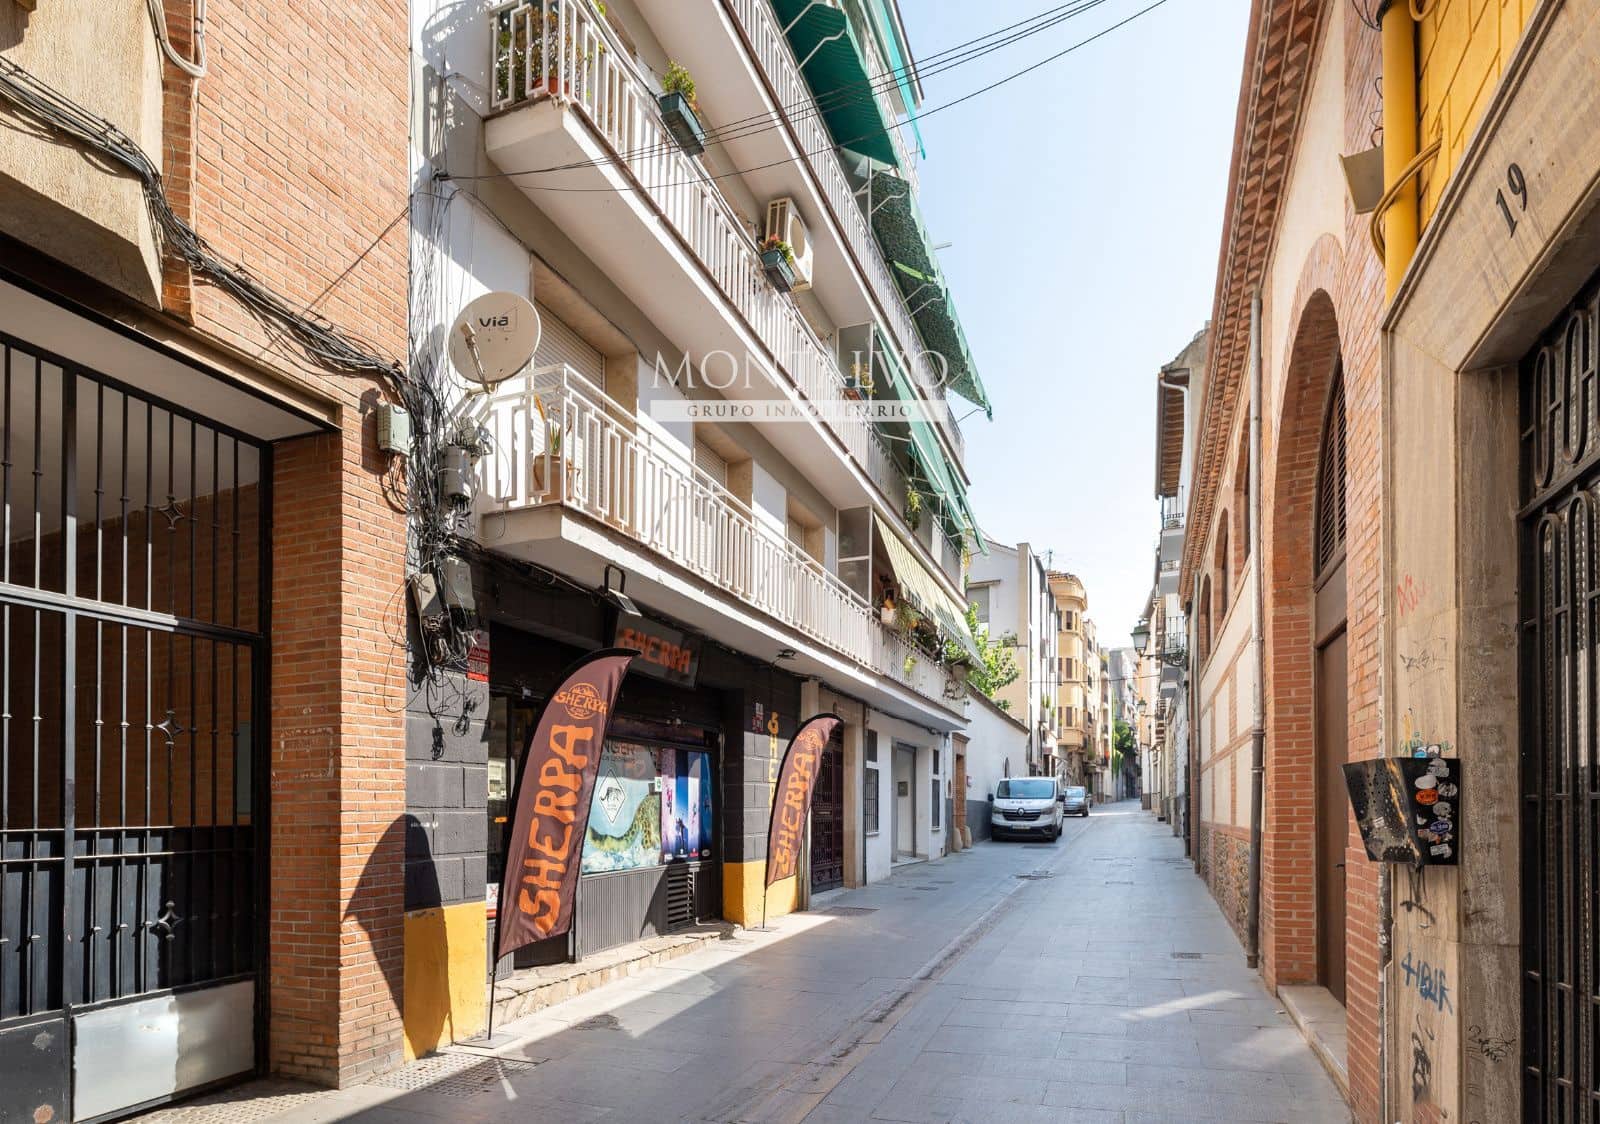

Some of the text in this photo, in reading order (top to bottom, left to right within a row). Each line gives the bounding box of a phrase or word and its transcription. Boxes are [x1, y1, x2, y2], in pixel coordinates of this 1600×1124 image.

[1495, 162, 1527, 239] 19
[518, 724, 594, 934] SHERPA
[775, 752, 816, 873] SHERPA
